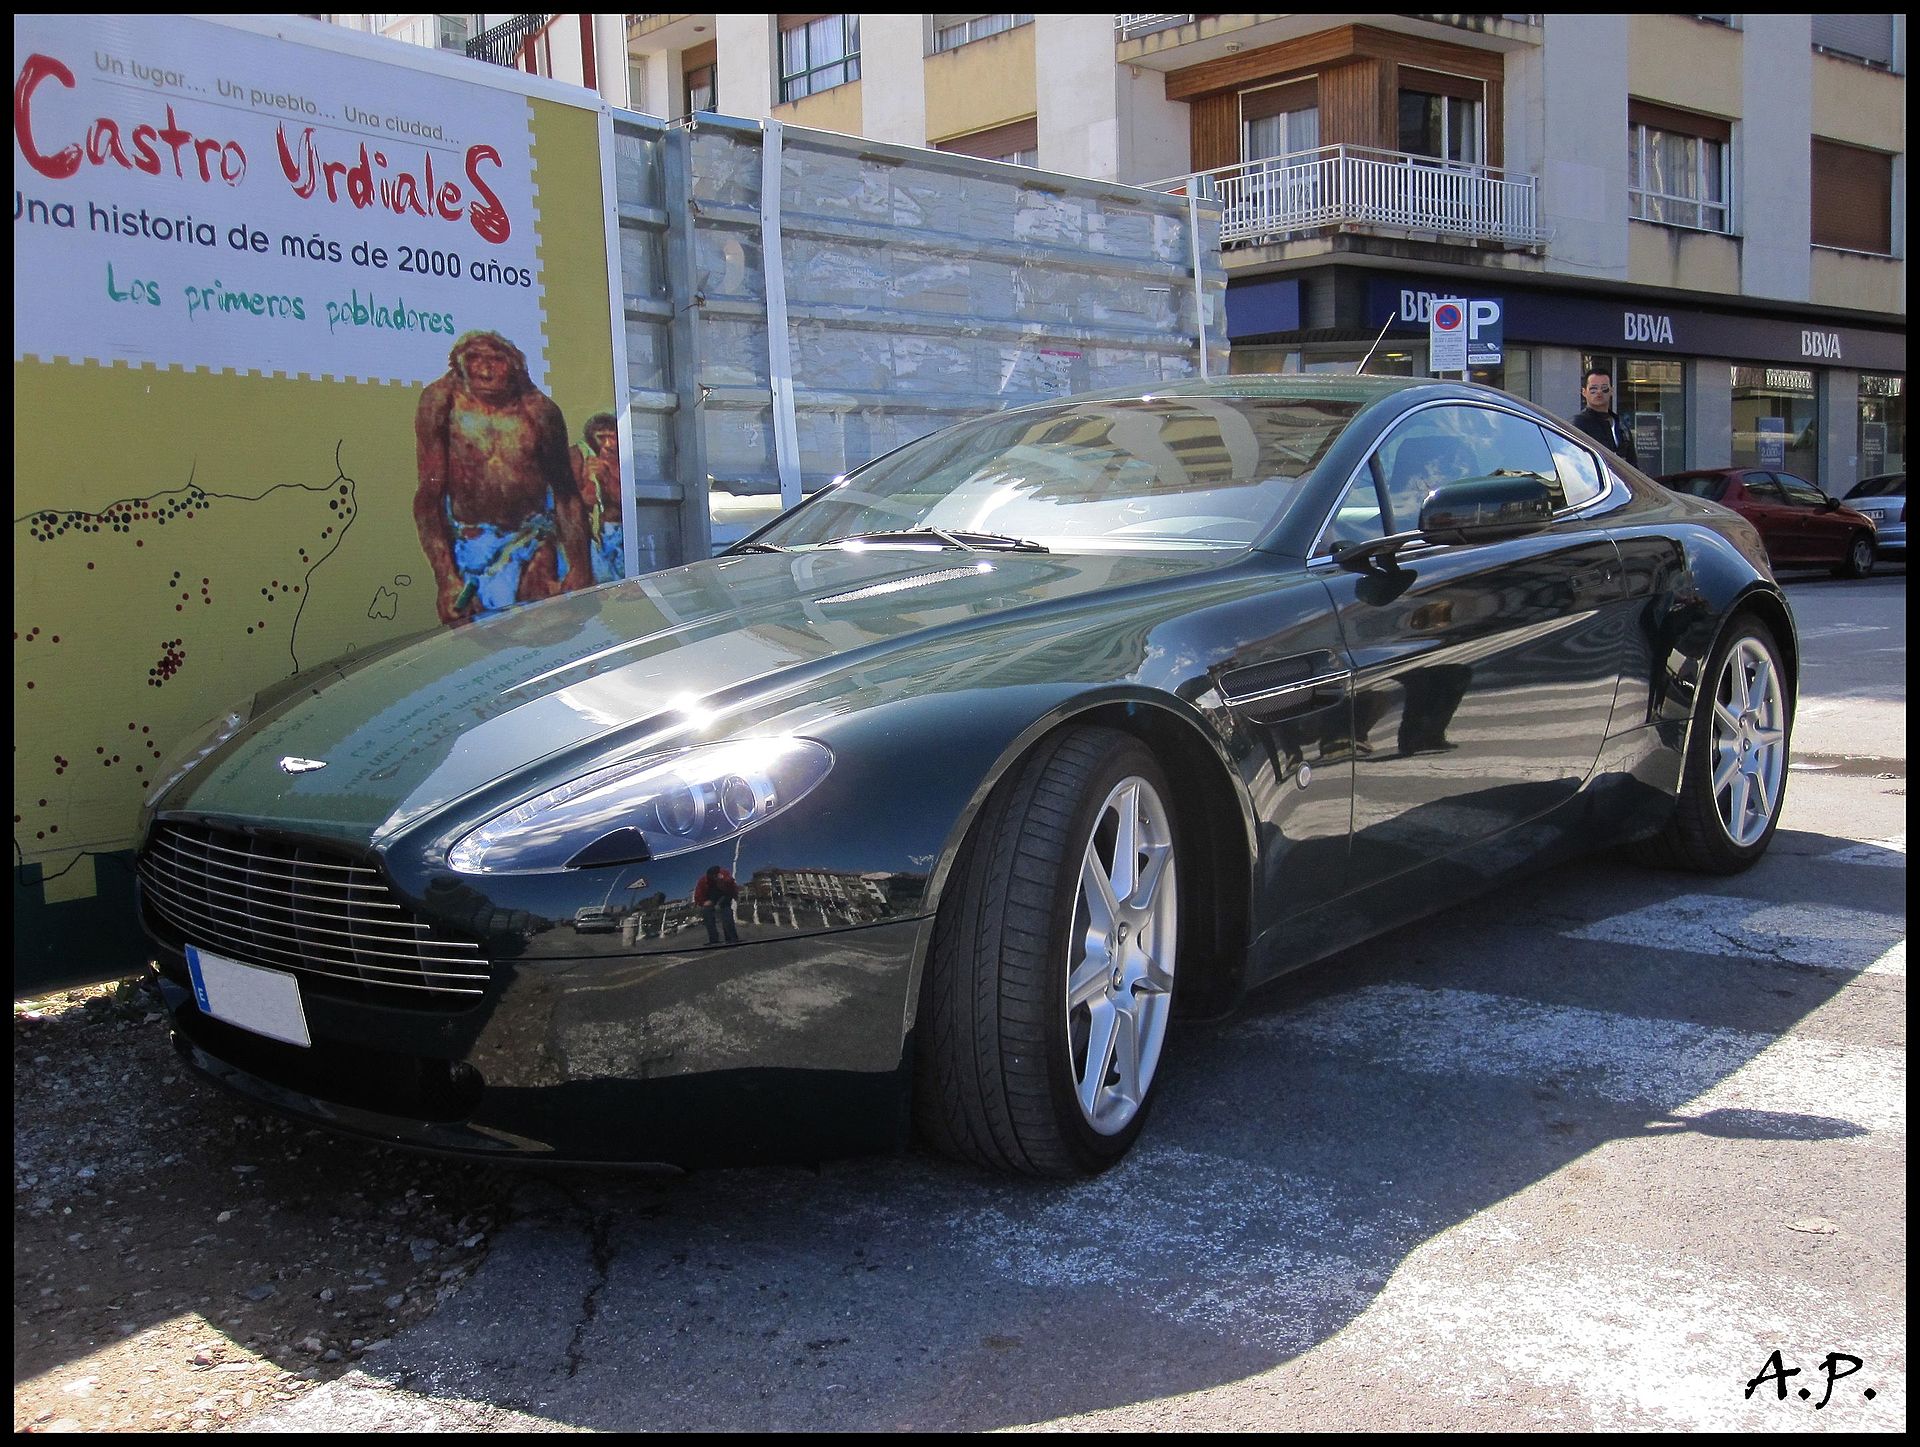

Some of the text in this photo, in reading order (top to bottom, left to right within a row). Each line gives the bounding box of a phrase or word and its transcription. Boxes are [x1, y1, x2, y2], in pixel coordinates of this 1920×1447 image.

[94, 51, 124, 75] Un
[217, 79, 244, 100] Un
[344, 105, 380, 128] Una
[15, 53, 248, 187] Castro
[89, 201, 217, 247] historia
[228, 223, 269, 253] de
[281, 233, 343, 263] más
[351, 240, 389, 268] de
[397, 246, 461, 278] 2000
[470, 259, 532, 288] años
[107, 261, 455, 335] Los primeros pobladores
[1469, 300, 1500, 340] P
[1624, 312, 1674, 344] BBVA
[1801, 330, 1842, 359] BBVA
[197, 987, 206, 1002] E
